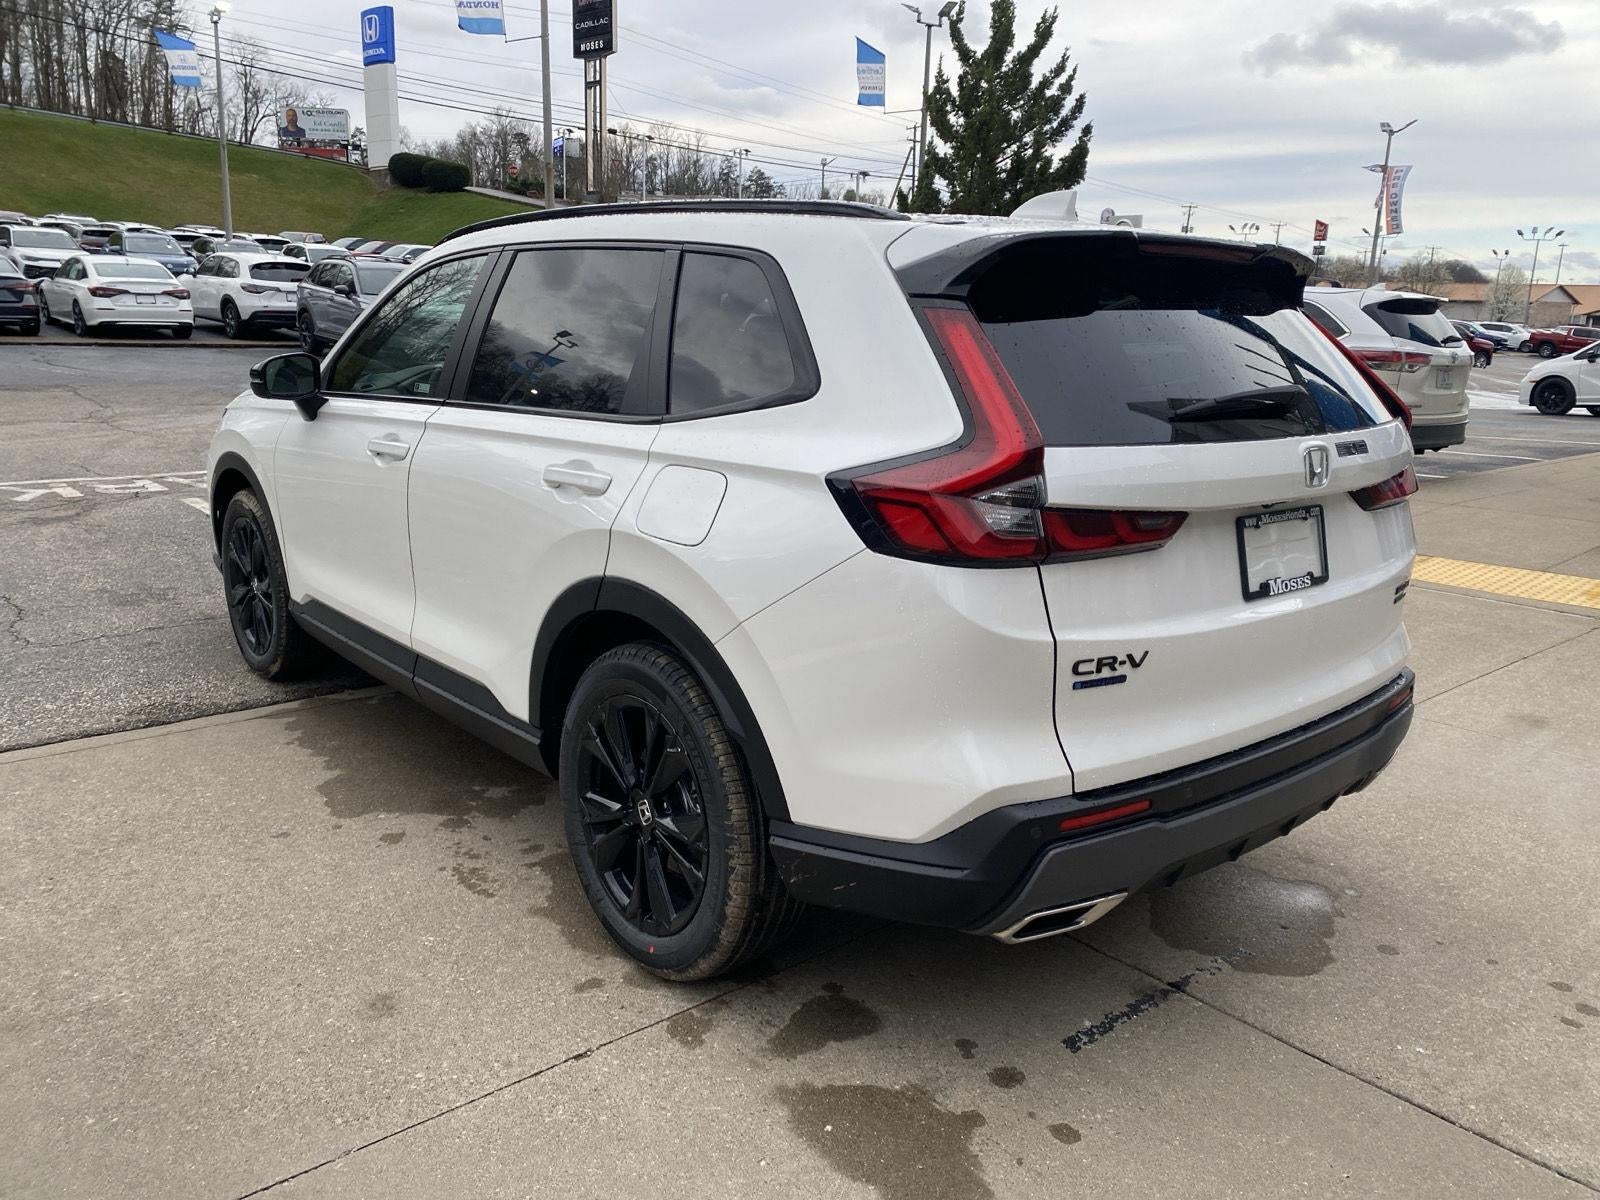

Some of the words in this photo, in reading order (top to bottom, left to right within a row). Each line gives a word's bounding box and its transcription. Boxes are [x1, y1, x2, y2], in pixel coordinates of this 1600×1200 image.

[575, 17, 609, 30] CADILLAC
[580, 40, 604, 52] MOSES
[1268, 576, 1312, 596] MOSES
[1072, 650, 1149, 676] CR-V
